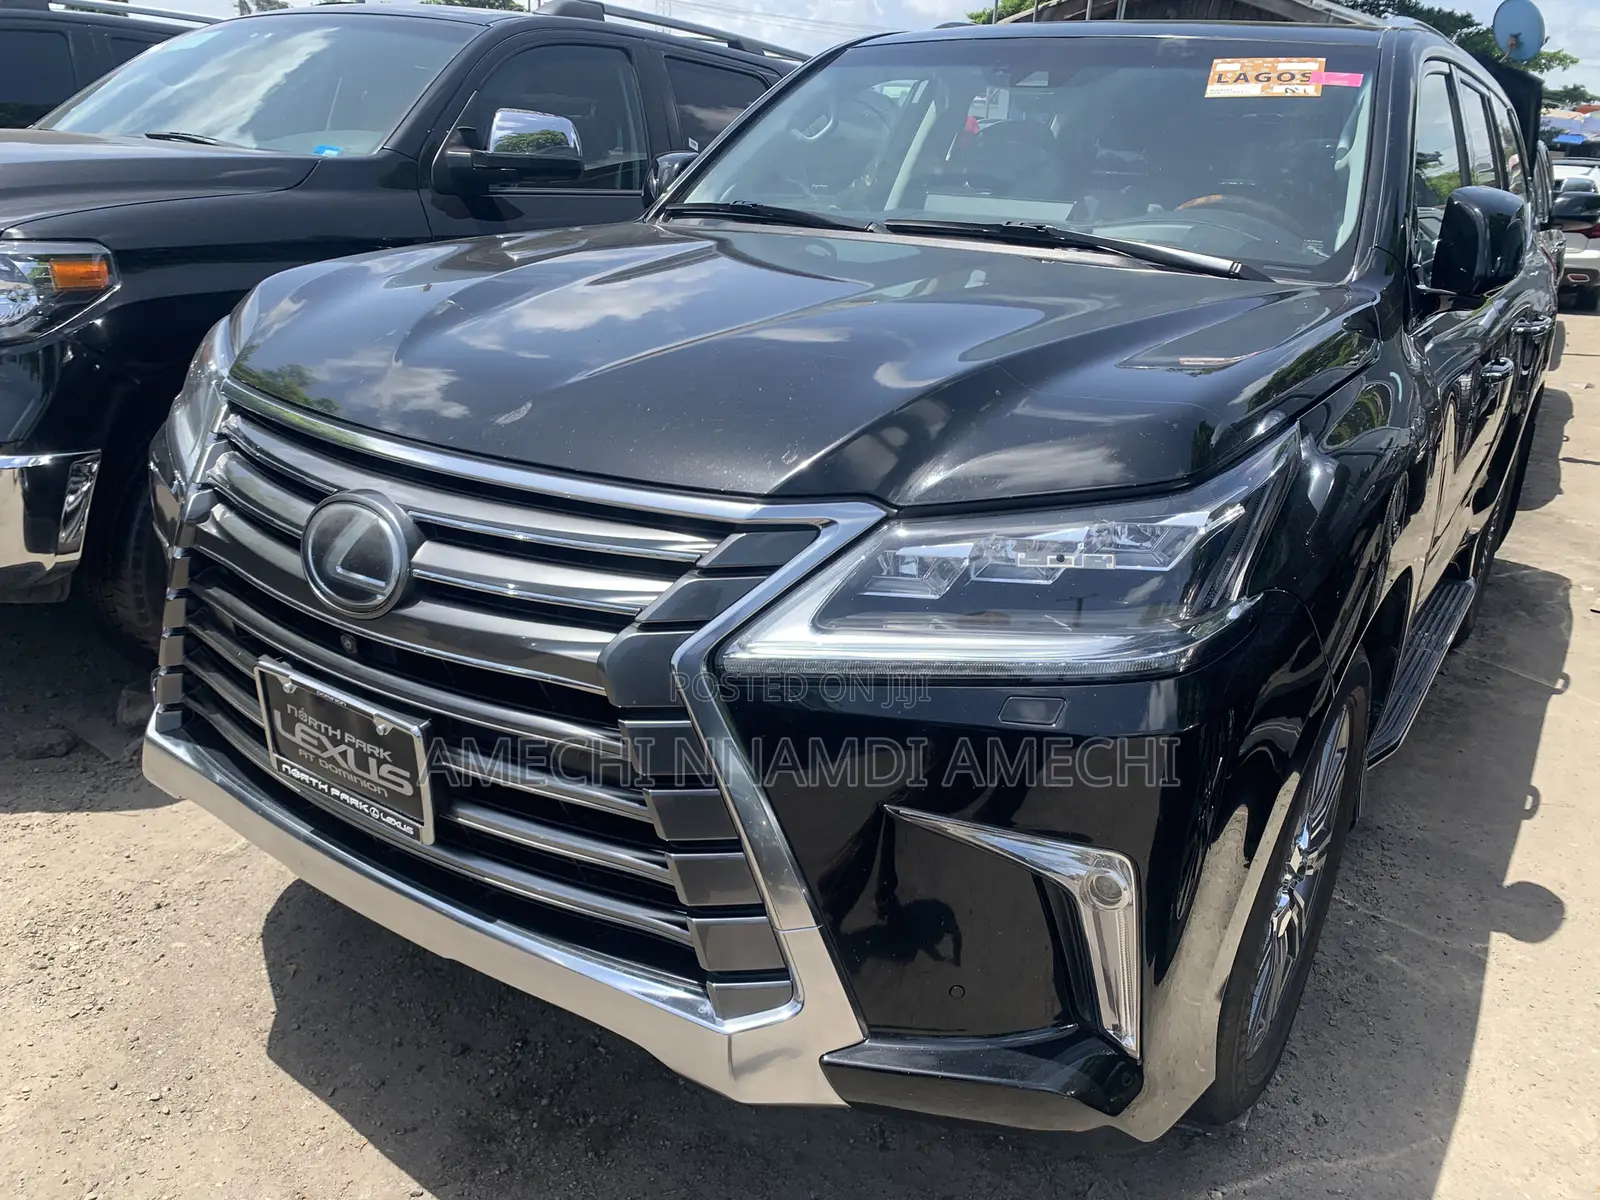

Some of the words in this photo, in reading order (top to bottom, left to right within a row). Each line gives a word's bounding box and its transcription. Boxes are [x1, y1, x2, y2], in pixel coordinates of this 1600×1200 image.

[1216, 72, 1312, 84] LAGOS
[273, 709, 414, 797] LEXUS
[344, 732, 393, 763] PARK
[330, 787, 370, 814] PARK
[380, 812, 414, 836] LEXUS
